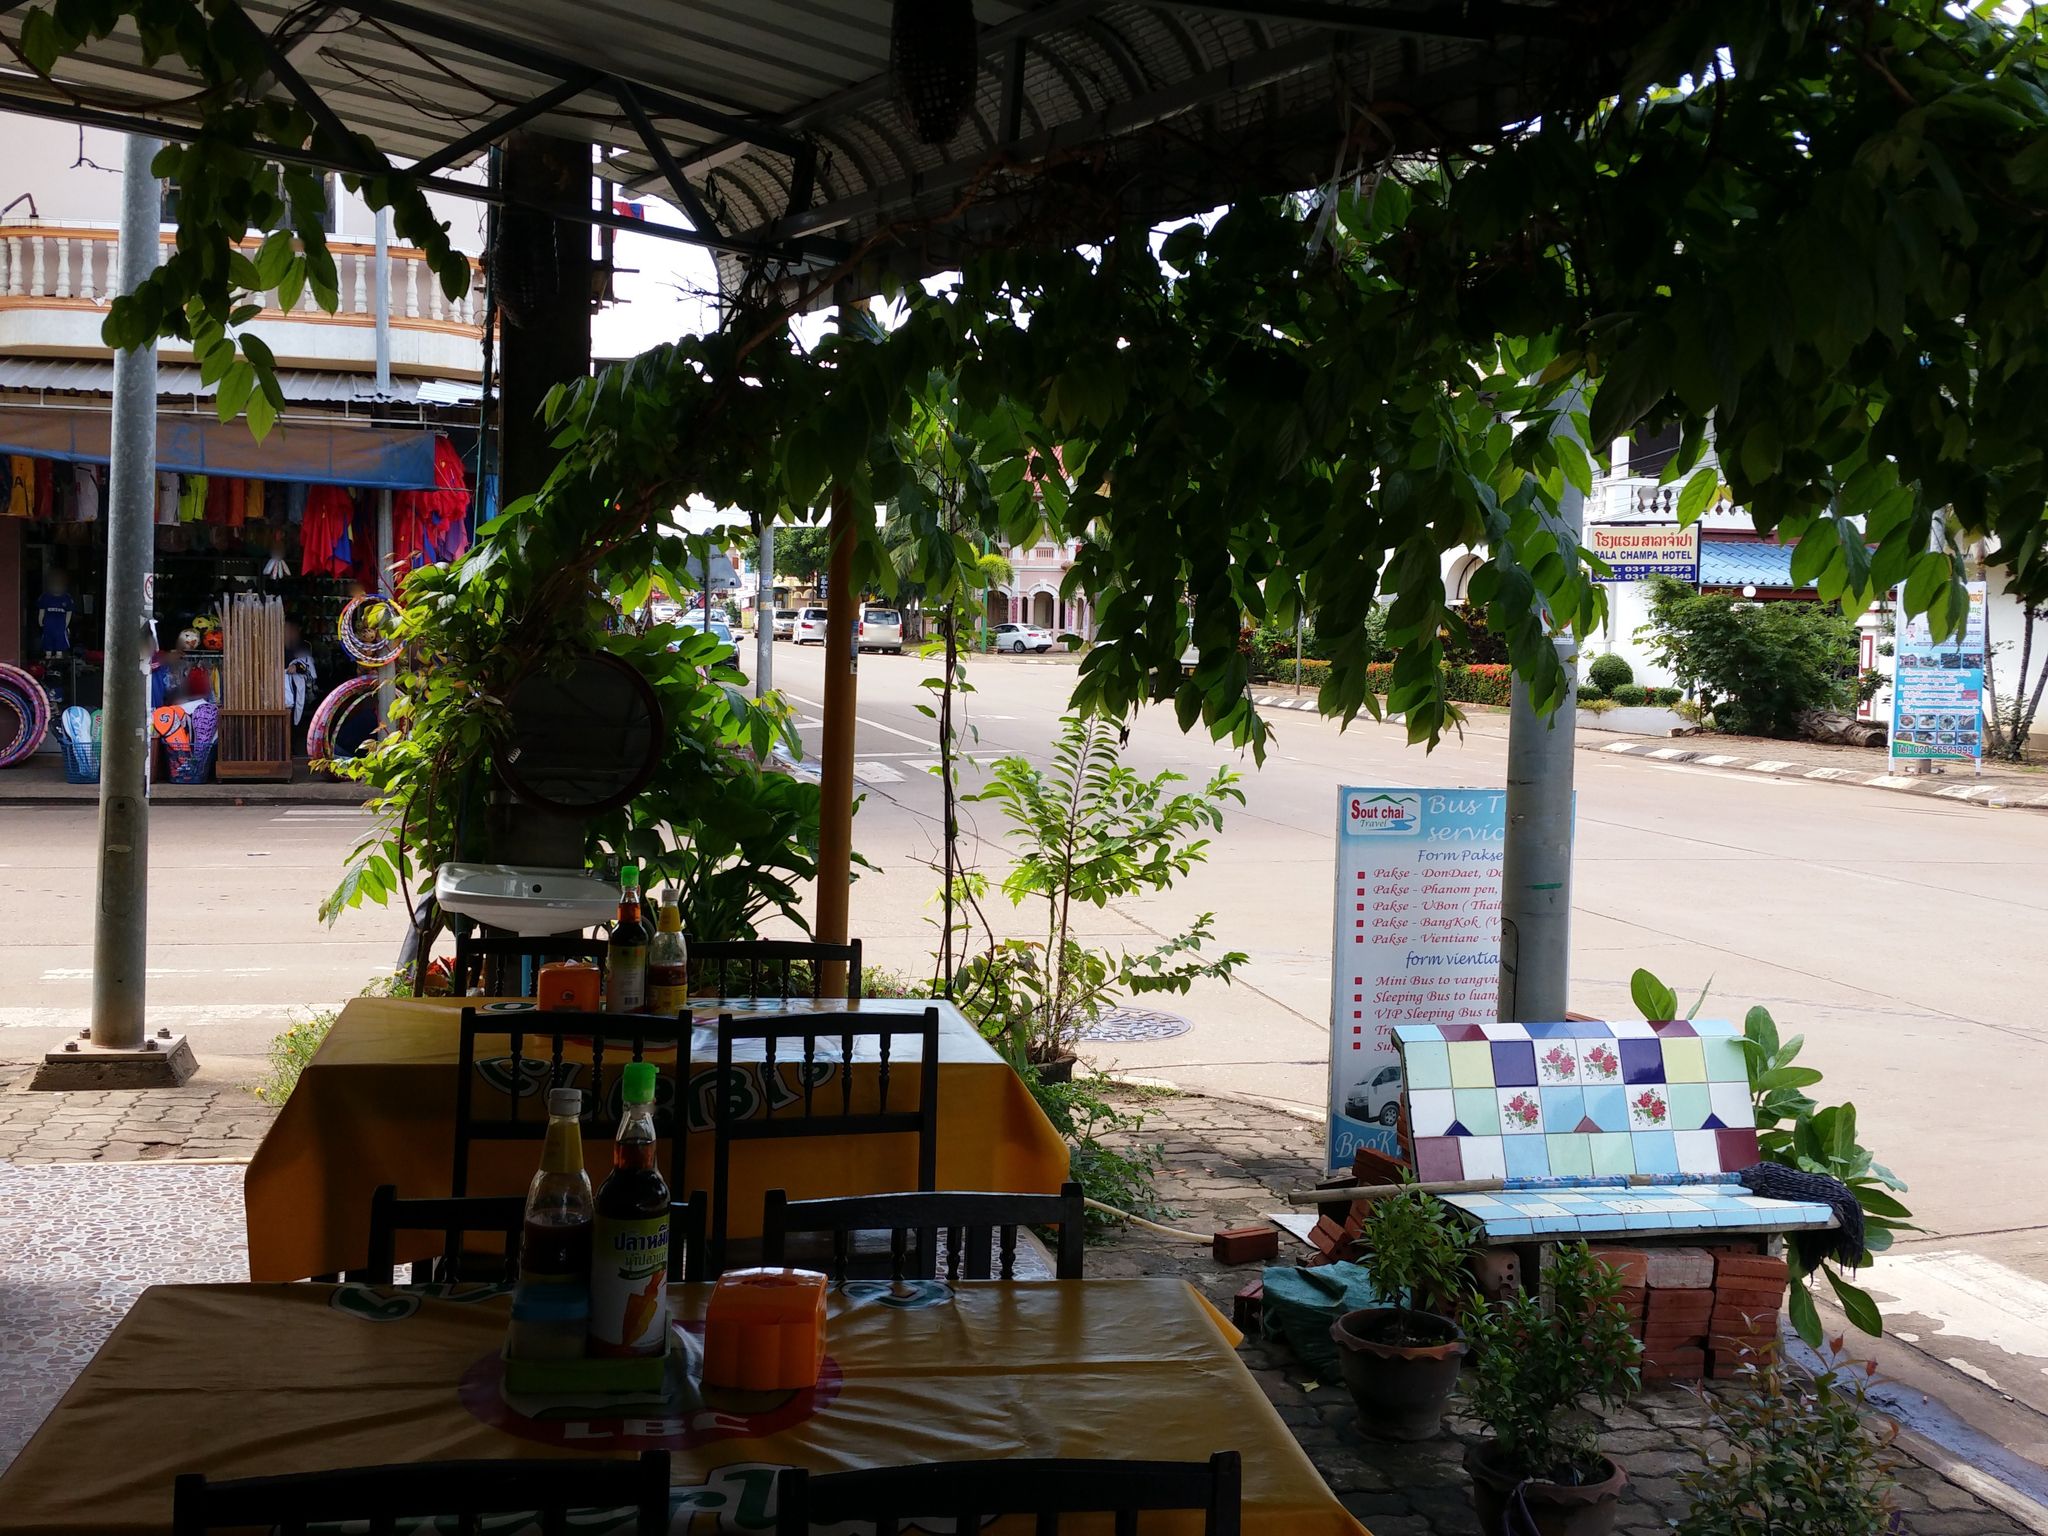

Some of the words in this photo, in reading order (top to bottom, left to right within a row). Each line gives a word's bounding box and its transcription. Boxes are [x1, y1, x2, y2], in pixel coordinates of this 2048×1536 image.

[1594, 550, 1617, 560] SALA
[1620, 550, 1658, 560] CHAMPA
[1662, 550, 1692, 560] HOTEL
[1897, 744, 1912, 753] Tel:
[1913, 746, 1930, 754] 020
[1932, 746, 1974, 755] 56521999
[1351, 799, 1378, 820] Sout
[1381, 806, 1404, 819] chai
[1427, 795, 1482, 815] Bus
[1488, 795, 1505, 814] T
[1360, 819, 1387, 828] Travel
[1427, 824, 1504, 842] servic
[1417, 849, 1460, 862] Form
[1462, 848, 1504, 862] Pakse
[1373, 867, 1410, 880] Pakse
[1421, 868, 1482, 879] DonDaet,
[1373, 884, 1410, 896] Pakse
[1421, 884, 1470, 895] Phanom
[1473, 886, 1498, 897] pen,
[1372, 900, 1409, 913] Pakse
[1422, 900, 1458, 911] UBon
[1470, 900, 1502, 911] Thail
[1372, 916, 1408, 929] Pakse
[1420, 917, 1481, 929] BangKok
[1486, 917, 1502, 929] (V
[1372, 934, 1408, 946] Pakse
[1420, 934, 1479, 943] Vientiane
[1406, 950, 1444, 968] form
[1446, 951, 1500, 965] vientia
[1376, 976, 1408, 986] Mini
[1410, 976, 1434, 986] Bus
[1438, 976, 1450, 985] to
[1373, 990, 1423, 1005] Sleeping
[1426, 990, 1450, 1002] Bus
[1454, 992, 1466, 1001] to
[1374, 1008, 1403, 1020] VIP
[1404, 1006, 1454, 1021] Sleeping
[1458, 1007, 1482, 1018] Bus
[1486, 1008, 1498, 1017] to
[1374, 1024, 1392, 1036] Tra
[1374, 1042, 1397, 1053] Sup
